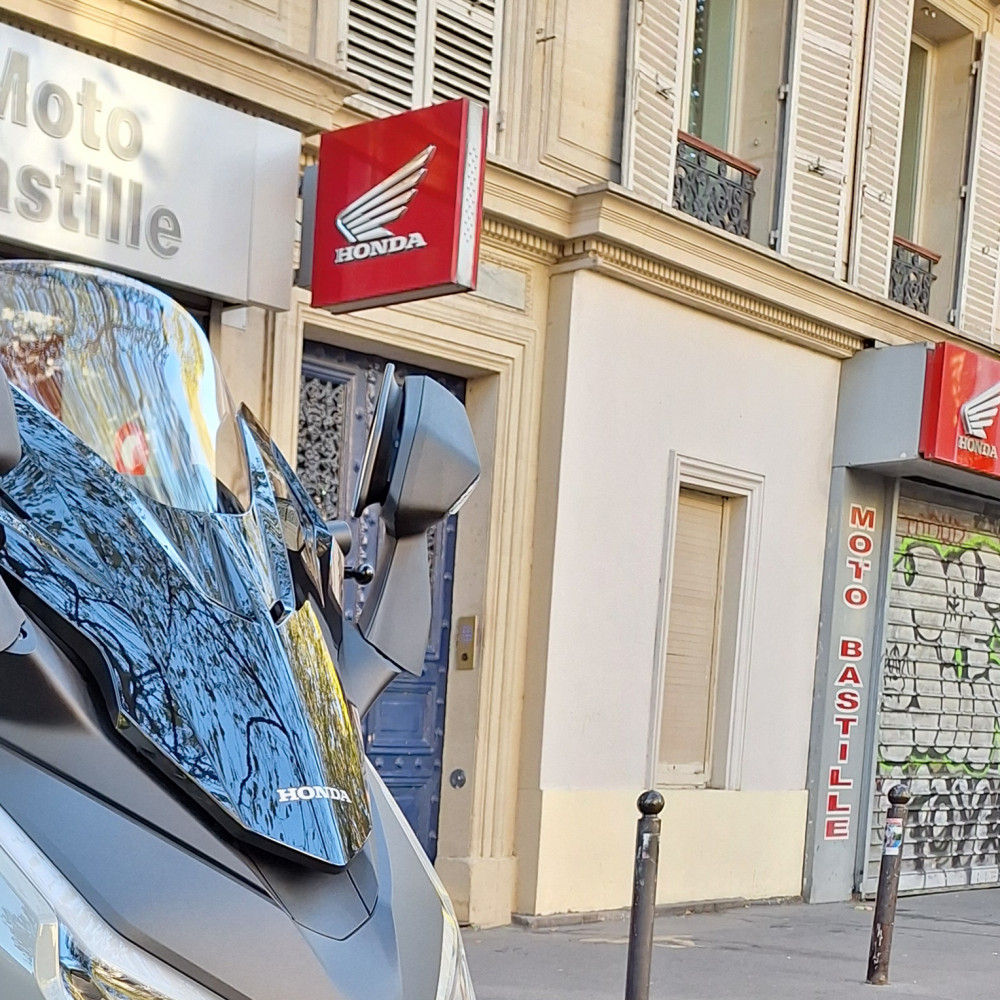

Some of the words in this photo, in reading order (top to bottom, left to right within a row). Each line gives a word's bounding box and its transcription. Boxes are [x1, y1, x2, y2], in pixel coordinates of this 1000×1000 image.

[334, 232, 428, 264] HONDA
[957, 435, 998, 460] HONDA
[844, 503, 876, 609] MOTO
[824, 634, 864, 840] BASTILLE
[276, 786, 352, 804] HONDA
